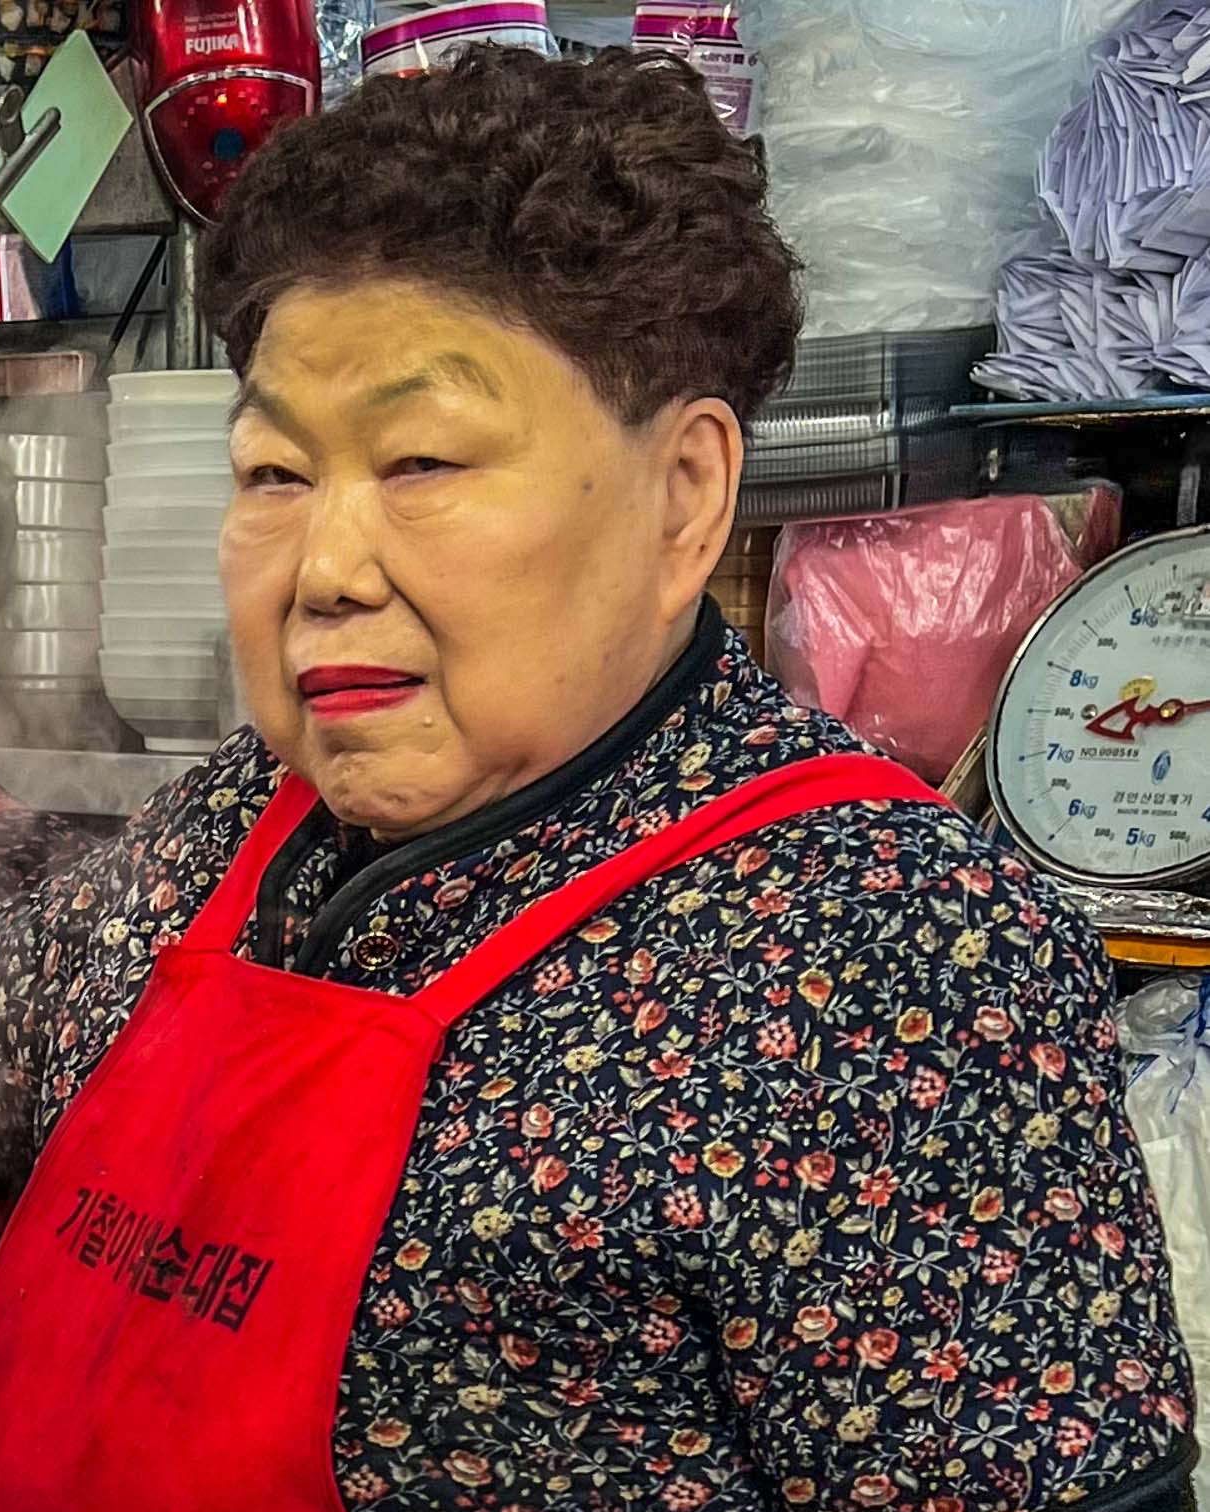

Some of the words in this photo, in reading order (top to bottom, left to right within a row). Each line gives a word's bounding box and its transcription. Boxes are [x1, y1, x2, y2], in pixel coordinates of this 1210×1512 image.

[185, 33, 239, 55] FUJIKA
[1069, 669, 1099, 689] 8kg
[1047, 743, 1075, 763] 7kg
[1068, 799, 1098, 820] 6kg
[1126, 827, 1157, 848] 5kg
